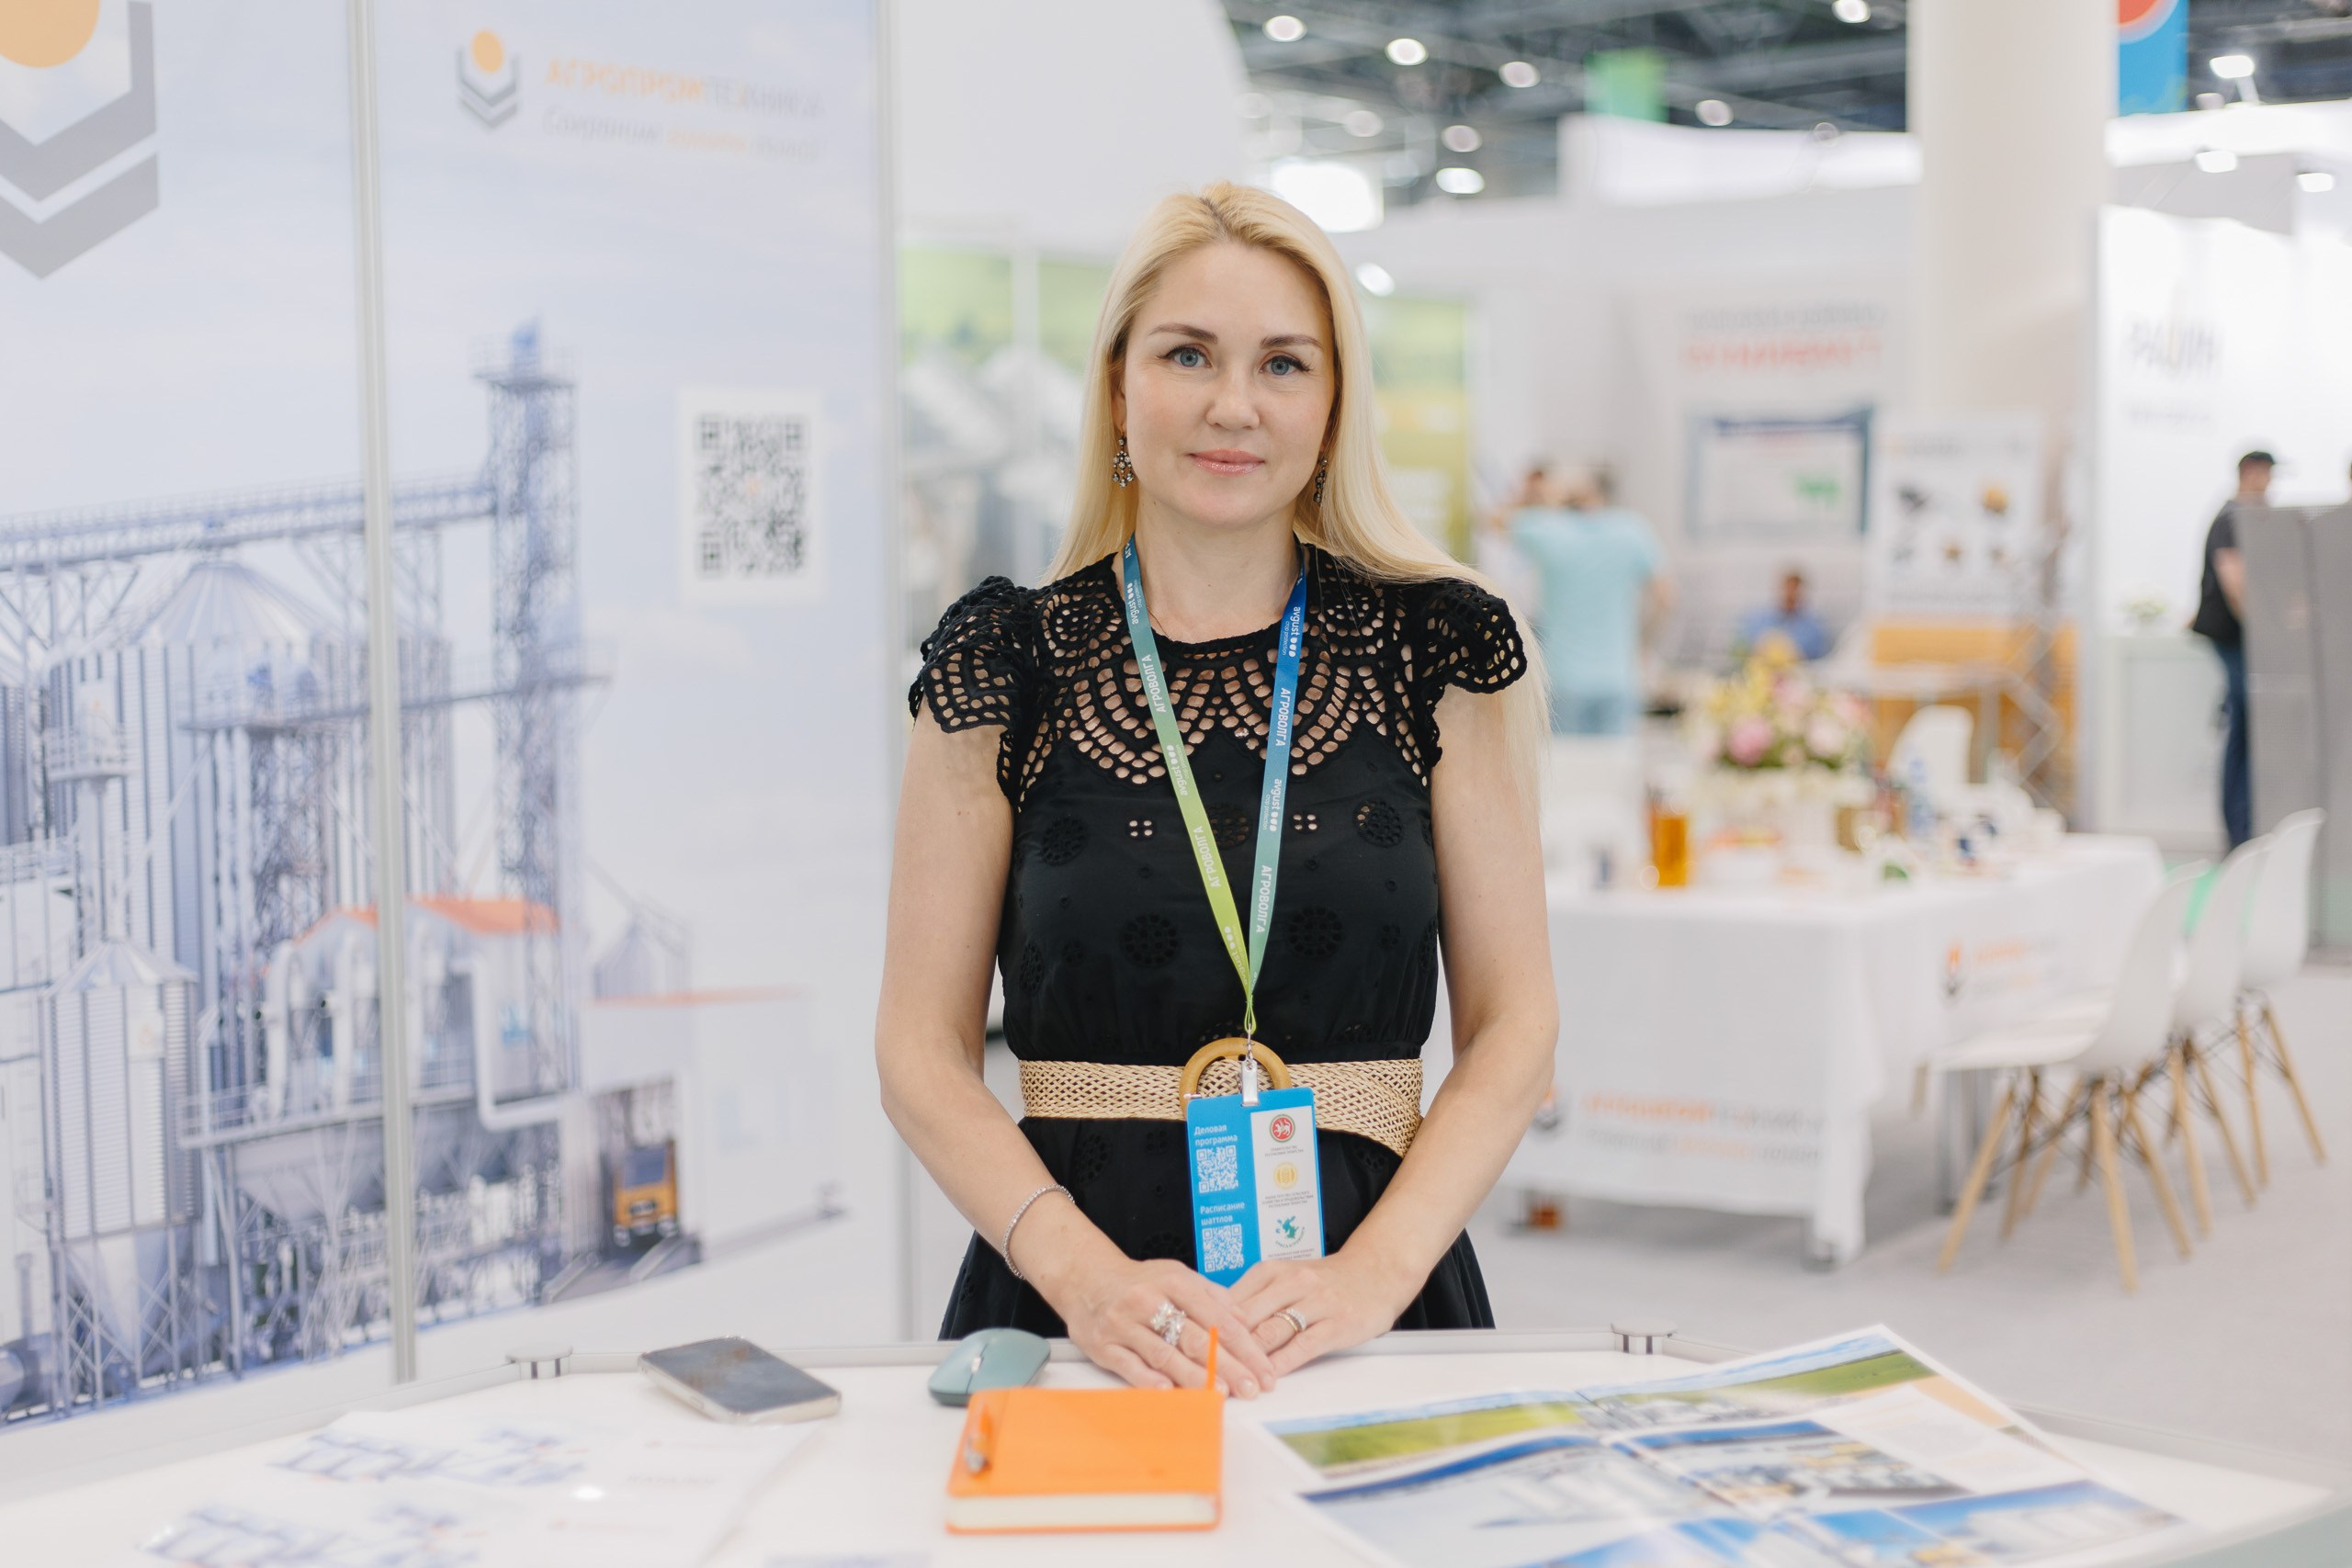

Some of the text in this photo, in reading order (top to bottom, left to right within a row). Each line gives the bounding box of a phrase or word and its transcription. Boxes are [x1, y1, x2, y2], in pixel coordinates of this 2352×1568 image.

[544, 57, 825, 119] АГРОПРОМТЕХНИКА
[1127, 598, 1140, 626] avgust
[1290, 606, 1302, 637] avgust
[1141, 654, 1167, 713] АГРОВОЛГА
[1275, 687, 1291, 747] АГРОВОЛГА
[1170, 765, 1189, 796] avgust
[1271, 777, 1283, 810] avgust
[1193, 825, 1221, 888] АГРОВОЛГА
[1256, 864, 1272, 933] АГРОВОЛГА
[1194, 1124, 1227, 1135] Деловая
[1195, 1134, 1238, 1146] программа
[1200, 1201, 1245, 1214] Расписание
[1201, 1214, 1234, 1226] шаттлов
